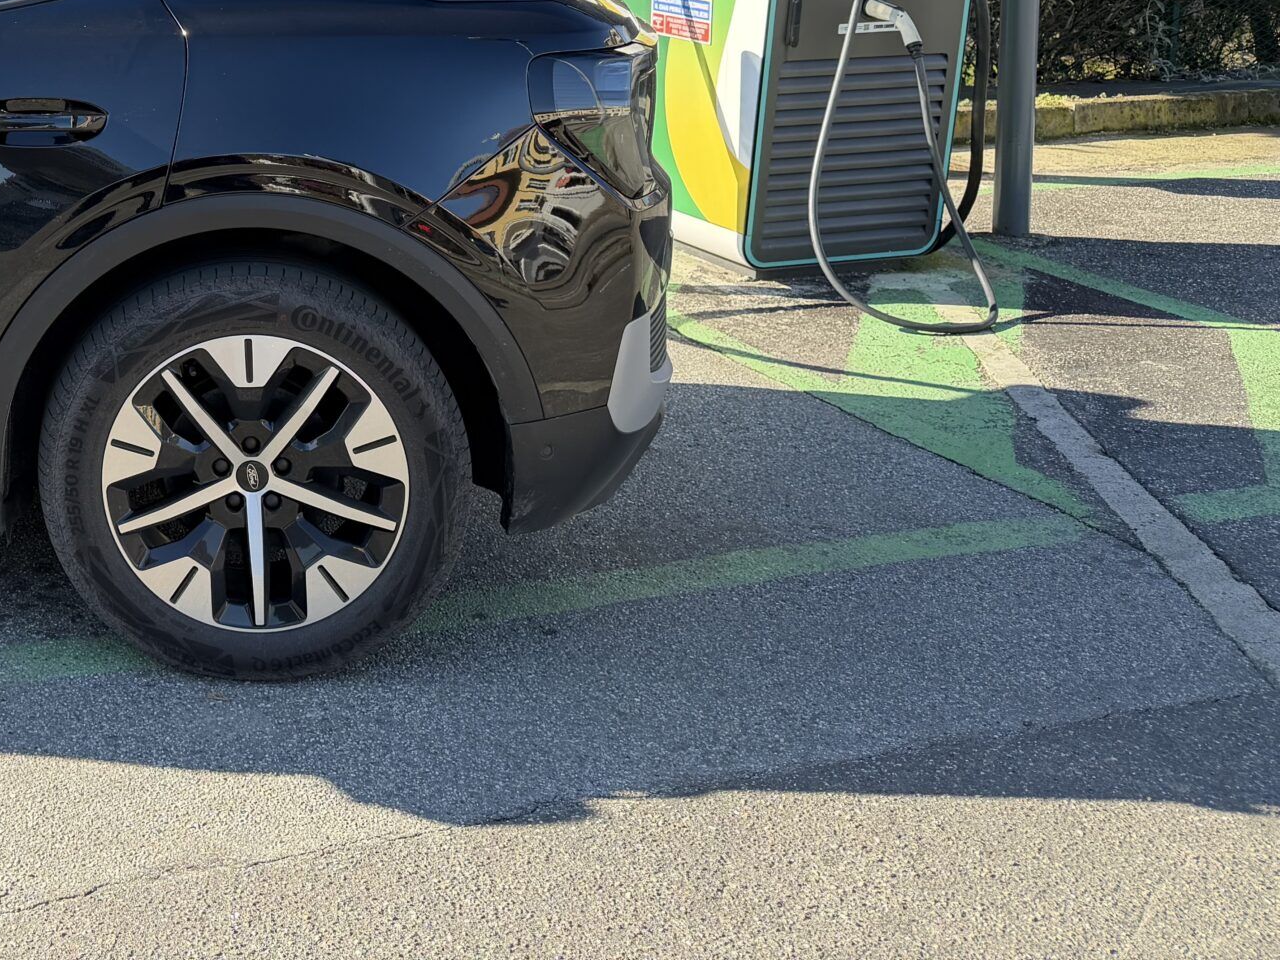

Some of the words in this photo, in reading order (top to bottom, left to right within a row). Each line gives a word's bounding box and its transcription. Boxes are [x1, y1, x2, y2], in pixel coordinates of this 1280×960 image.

[291, 305, 421, 401] Continental
[65, 458, 80, 472] R
[68, 437, 84, 456] 19
[64, 475, 86, 537] 255/50
